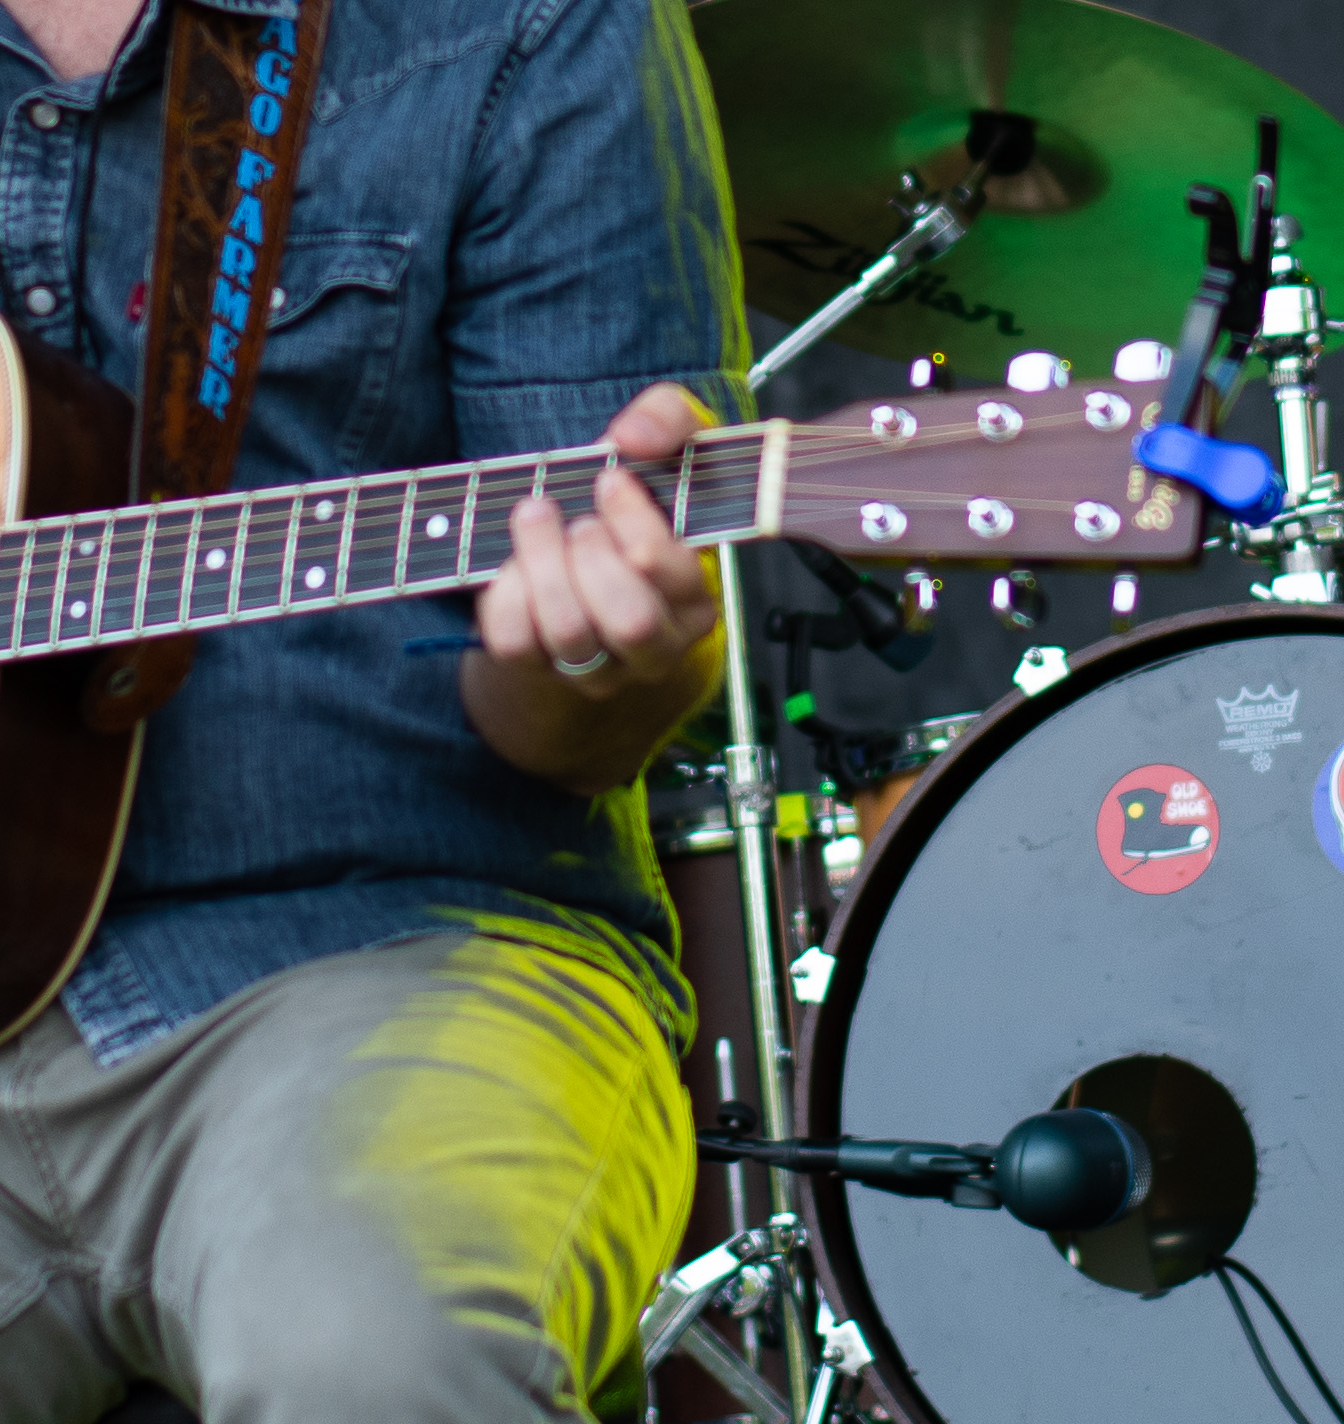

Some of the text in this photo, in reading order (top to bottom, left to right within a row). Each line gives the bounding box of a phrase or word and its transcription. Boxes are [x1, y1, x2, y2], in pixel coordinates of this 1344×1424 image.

[196, 147, 277, 423] FARMER
[1229, 701, 1287, 719] REMO
[1171, 781, 1198, 800] OLD
[1166, 799, 1207, 819] SHOE
